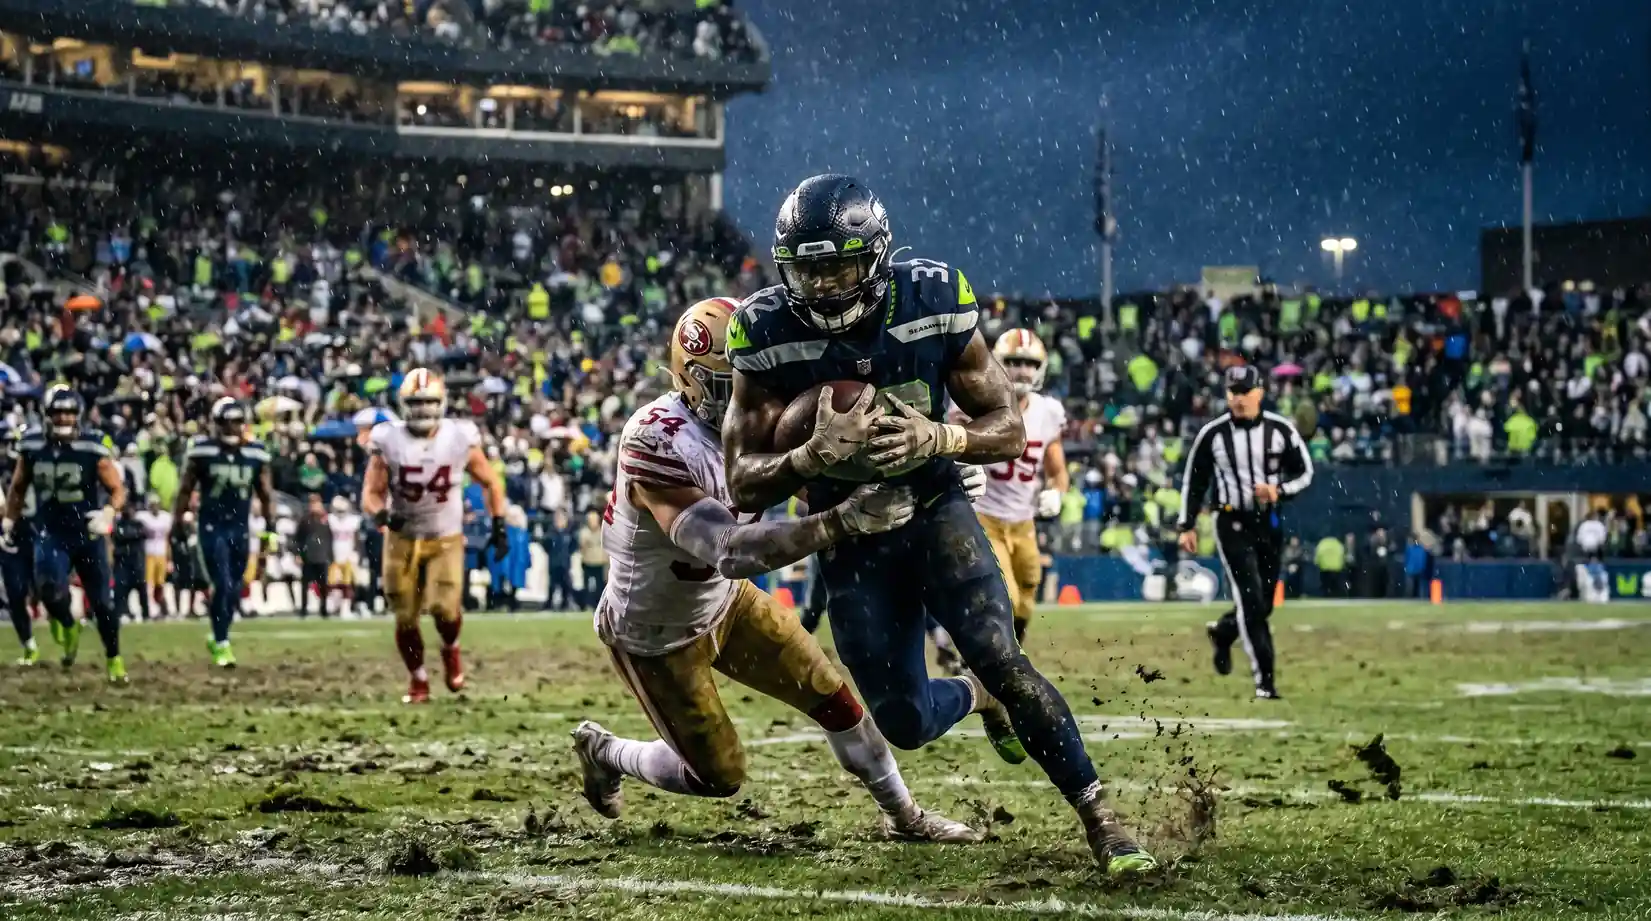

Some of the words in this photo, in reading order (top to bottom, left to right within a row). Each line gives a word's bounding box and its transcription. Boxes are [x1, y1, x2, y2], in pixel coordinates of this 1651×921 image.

[639, 407, 688, 437] 54
[208, 463, 252, 500] 74
[399, 465, 452, 503] 54
